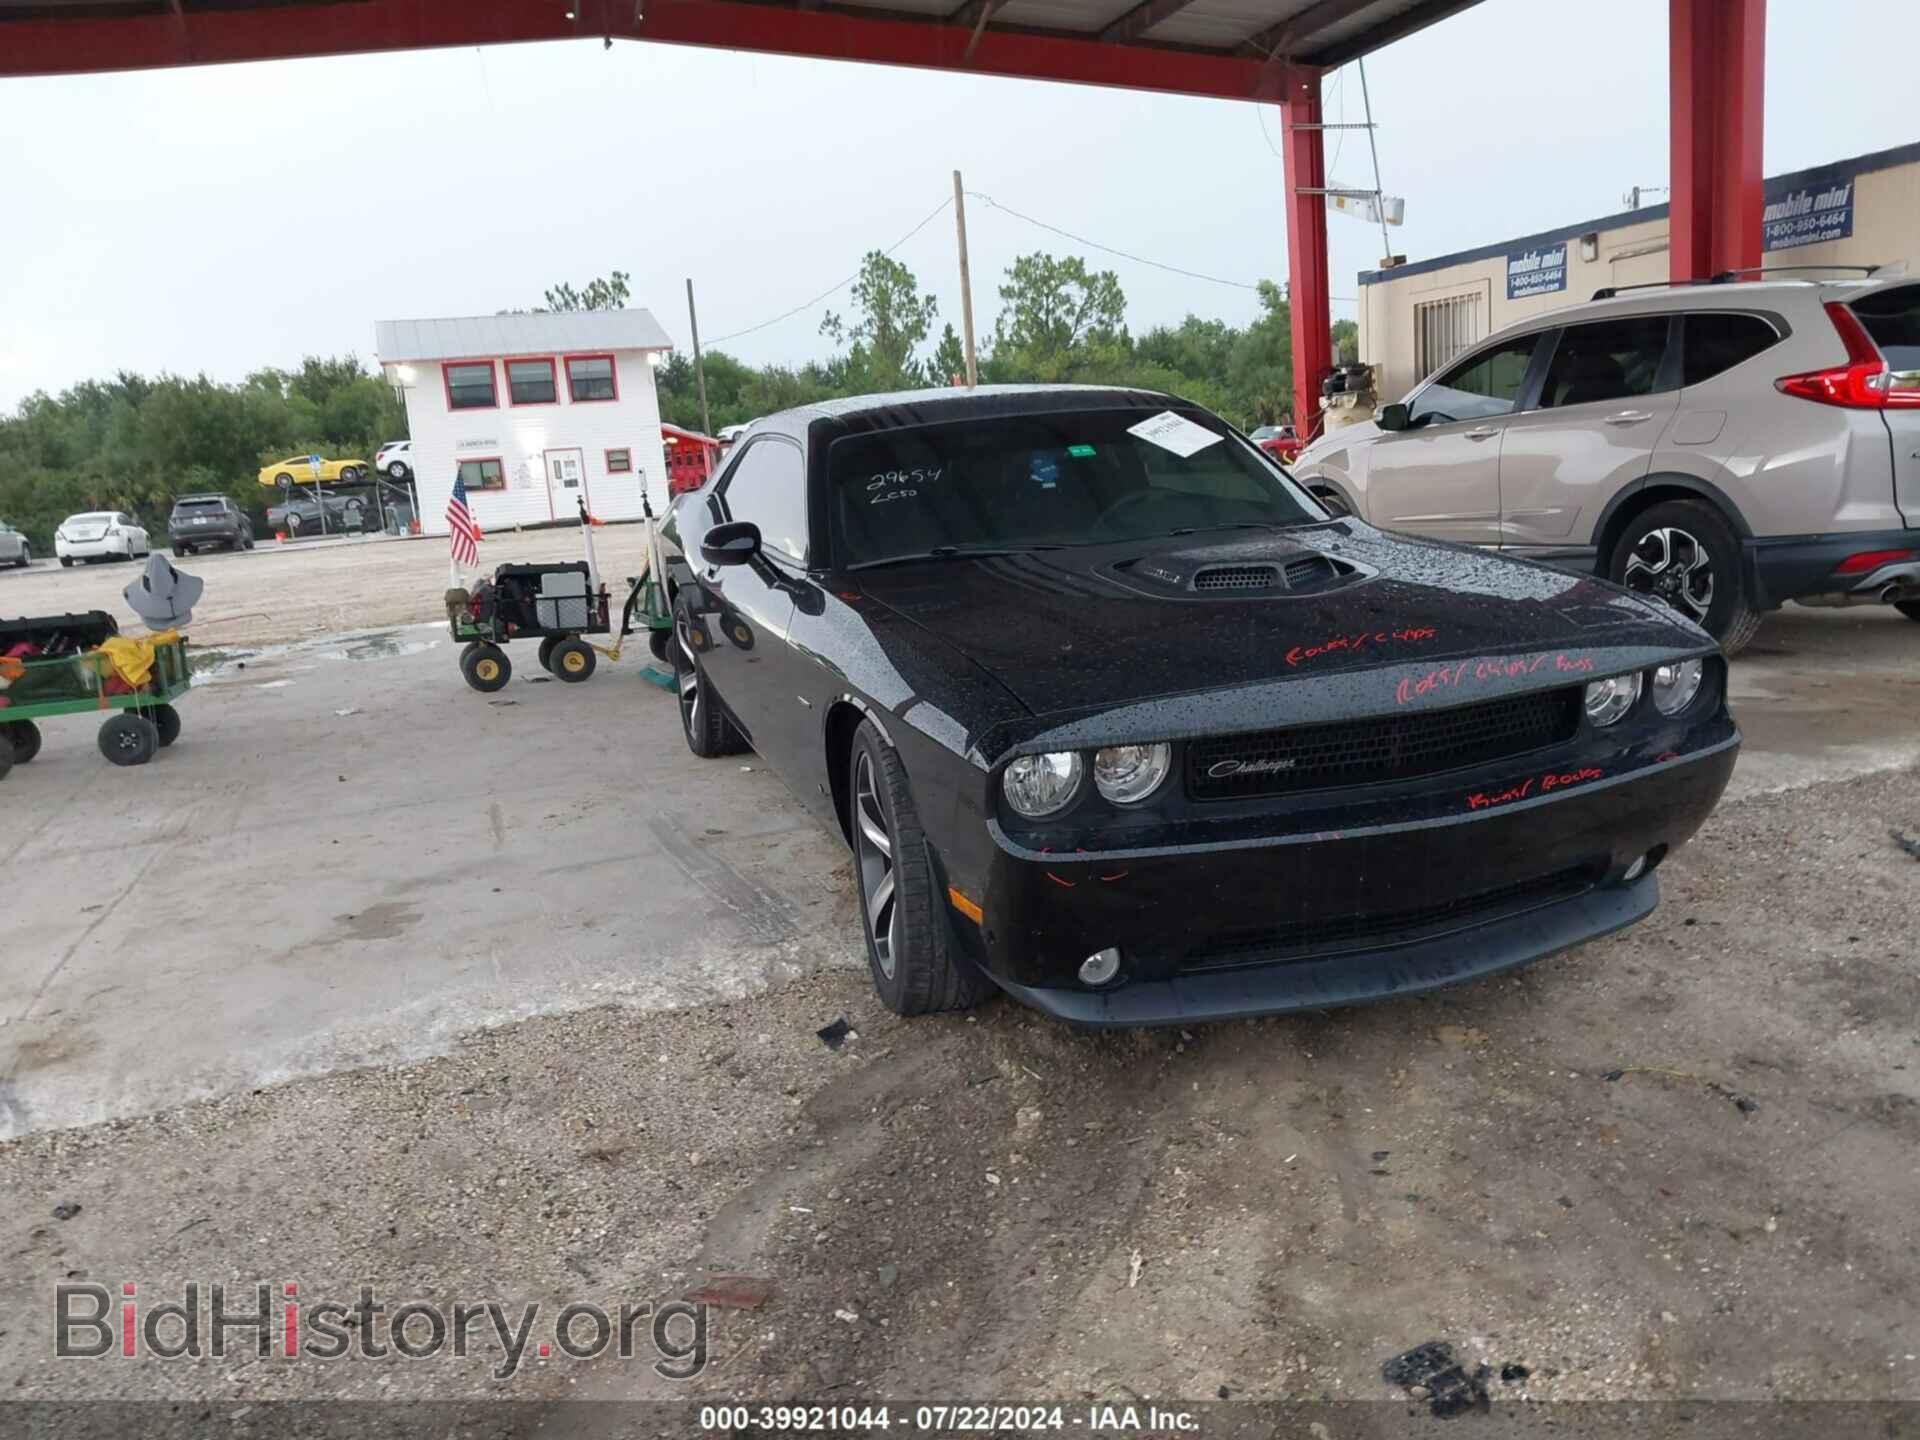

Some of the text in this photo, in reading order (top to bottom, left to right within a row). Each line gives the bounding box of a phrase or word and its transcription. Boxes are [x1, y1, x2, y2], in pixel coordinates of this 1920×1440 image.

[1763, 183, 1853, 222] mobile mini
[1509, 247, 1566, 275] mobile mini
[866, 468, 942, 490] 29654
[1207, 759, 1296, 778] Challenger
